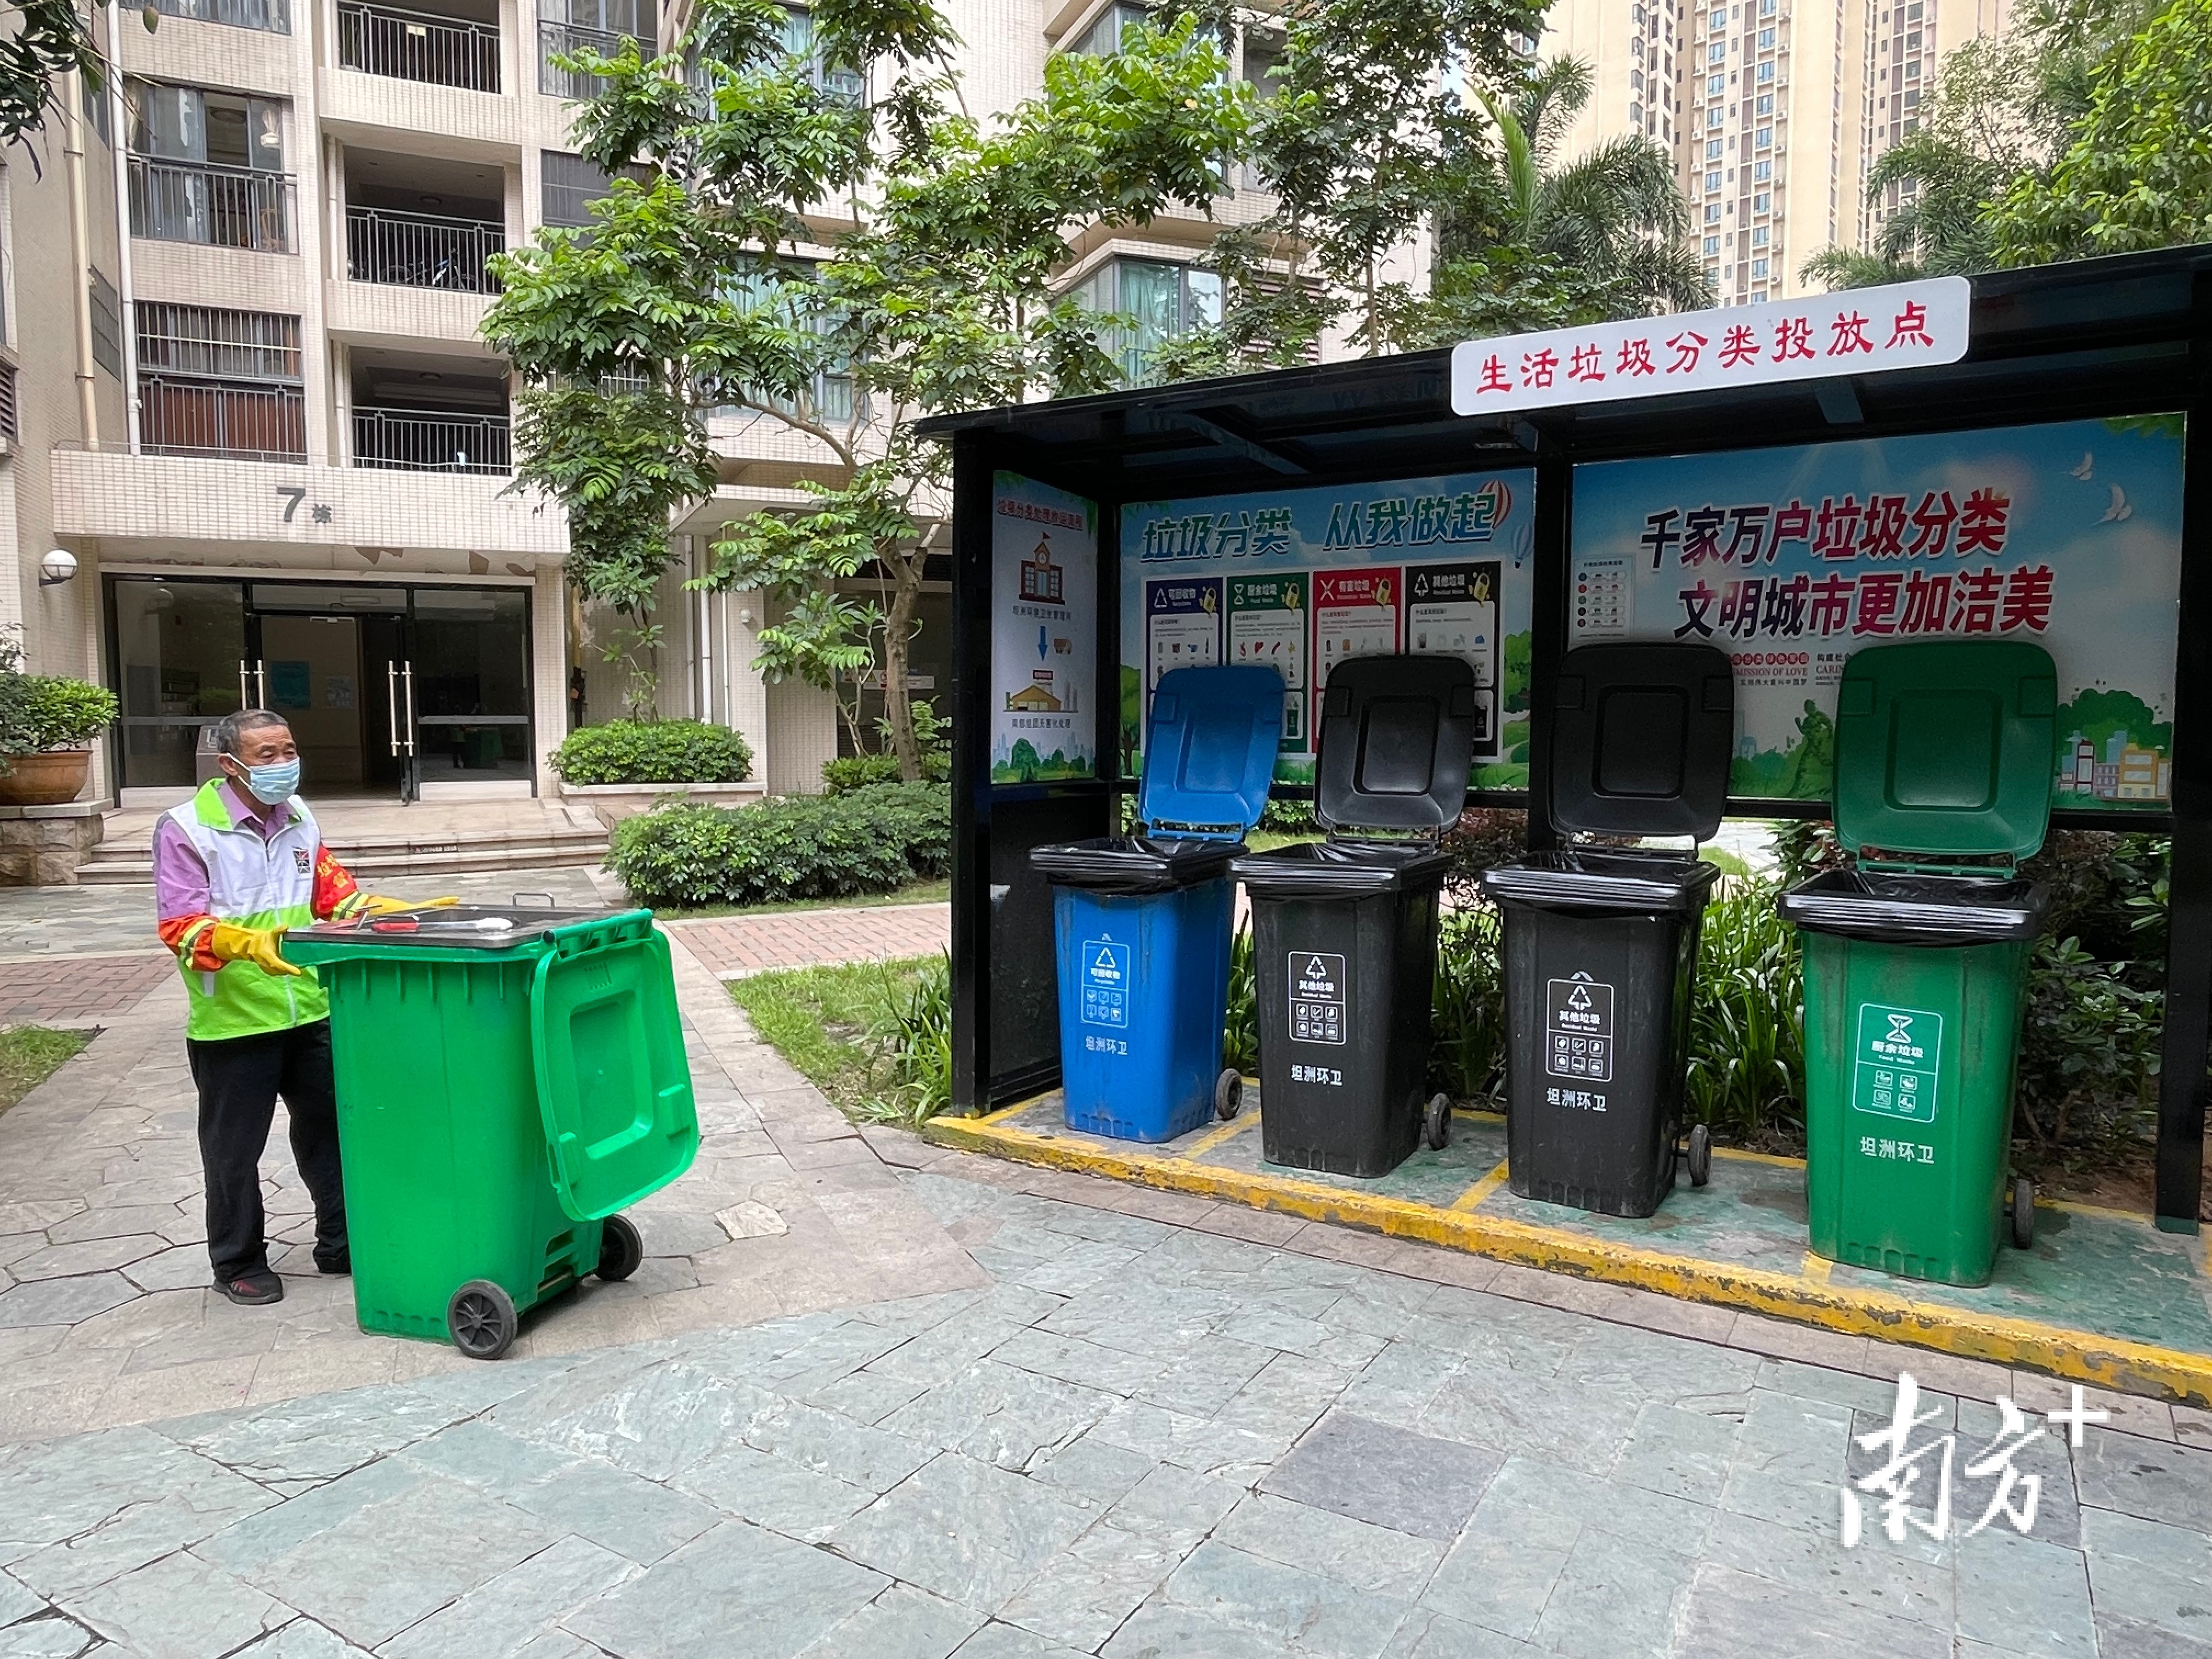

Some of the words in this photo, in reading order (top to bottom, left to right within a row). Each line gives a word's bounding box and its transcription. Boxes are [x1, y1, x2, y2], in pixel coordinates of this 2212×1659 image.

[1476, 300, 1935, 395] 生活垃圾分类投放点
[1141, 506, 1291, 562] 垃圾分类
[1323, 492, 1497, 551] 从我做起
[1641, 486, 2010, 569] 千家万户垃圾分类
[1673, 565, 2055, 640] 文明城市更加洁美
[1773, 668, 1784, 676] OF
[1785, 667, 1808, 676] LOVE
[1299, 980, 1334, 992] 其他垃圾
[1559, 1011, 1600, 1025] 其他垃圾
[1085, 1035, 1128, 1056] 坦洲环卫
[1871, 1040, 1923, 1059] 厨余垃圾
[1290, 1064, 1343, 1086] 坦洲环卫
[1546, 1087, 1607, 1113] 坦洲环卫
[1860, 1136, 1935, 1165] 坦洲环卫
